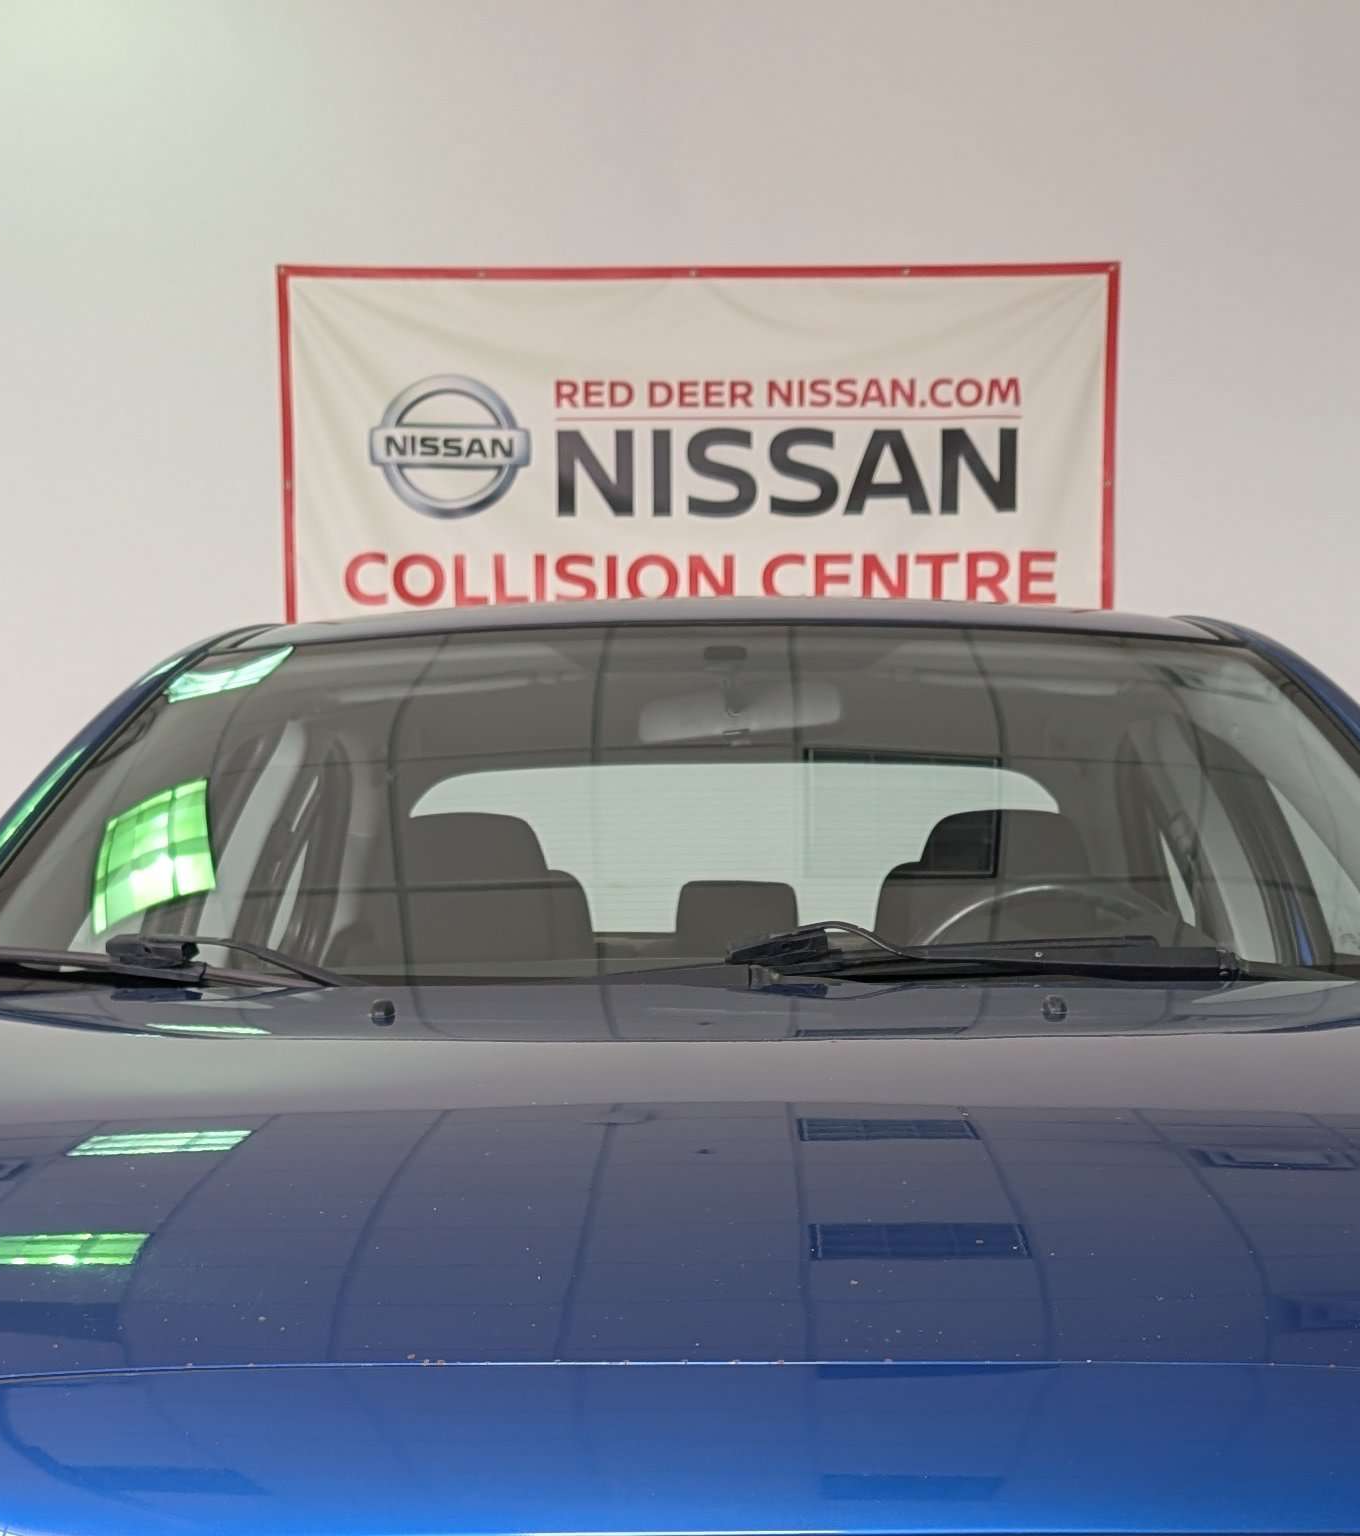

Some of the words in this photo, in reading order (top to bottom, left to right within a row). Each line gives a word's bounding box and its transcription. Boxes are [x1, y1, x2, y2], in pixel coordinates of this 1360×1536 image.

[555, 380, 635, 409] RED
[648, 380, 754, 409] DEER
[767, 377, 1021, 408] NISSAN.COM
[384, 435, 515, 459] NISSAN
[555, 427, 1018, 517] NISSAN
[343, 552, 735, 607] COLLISION
[761, 550, 1056, 603] CENTRE
